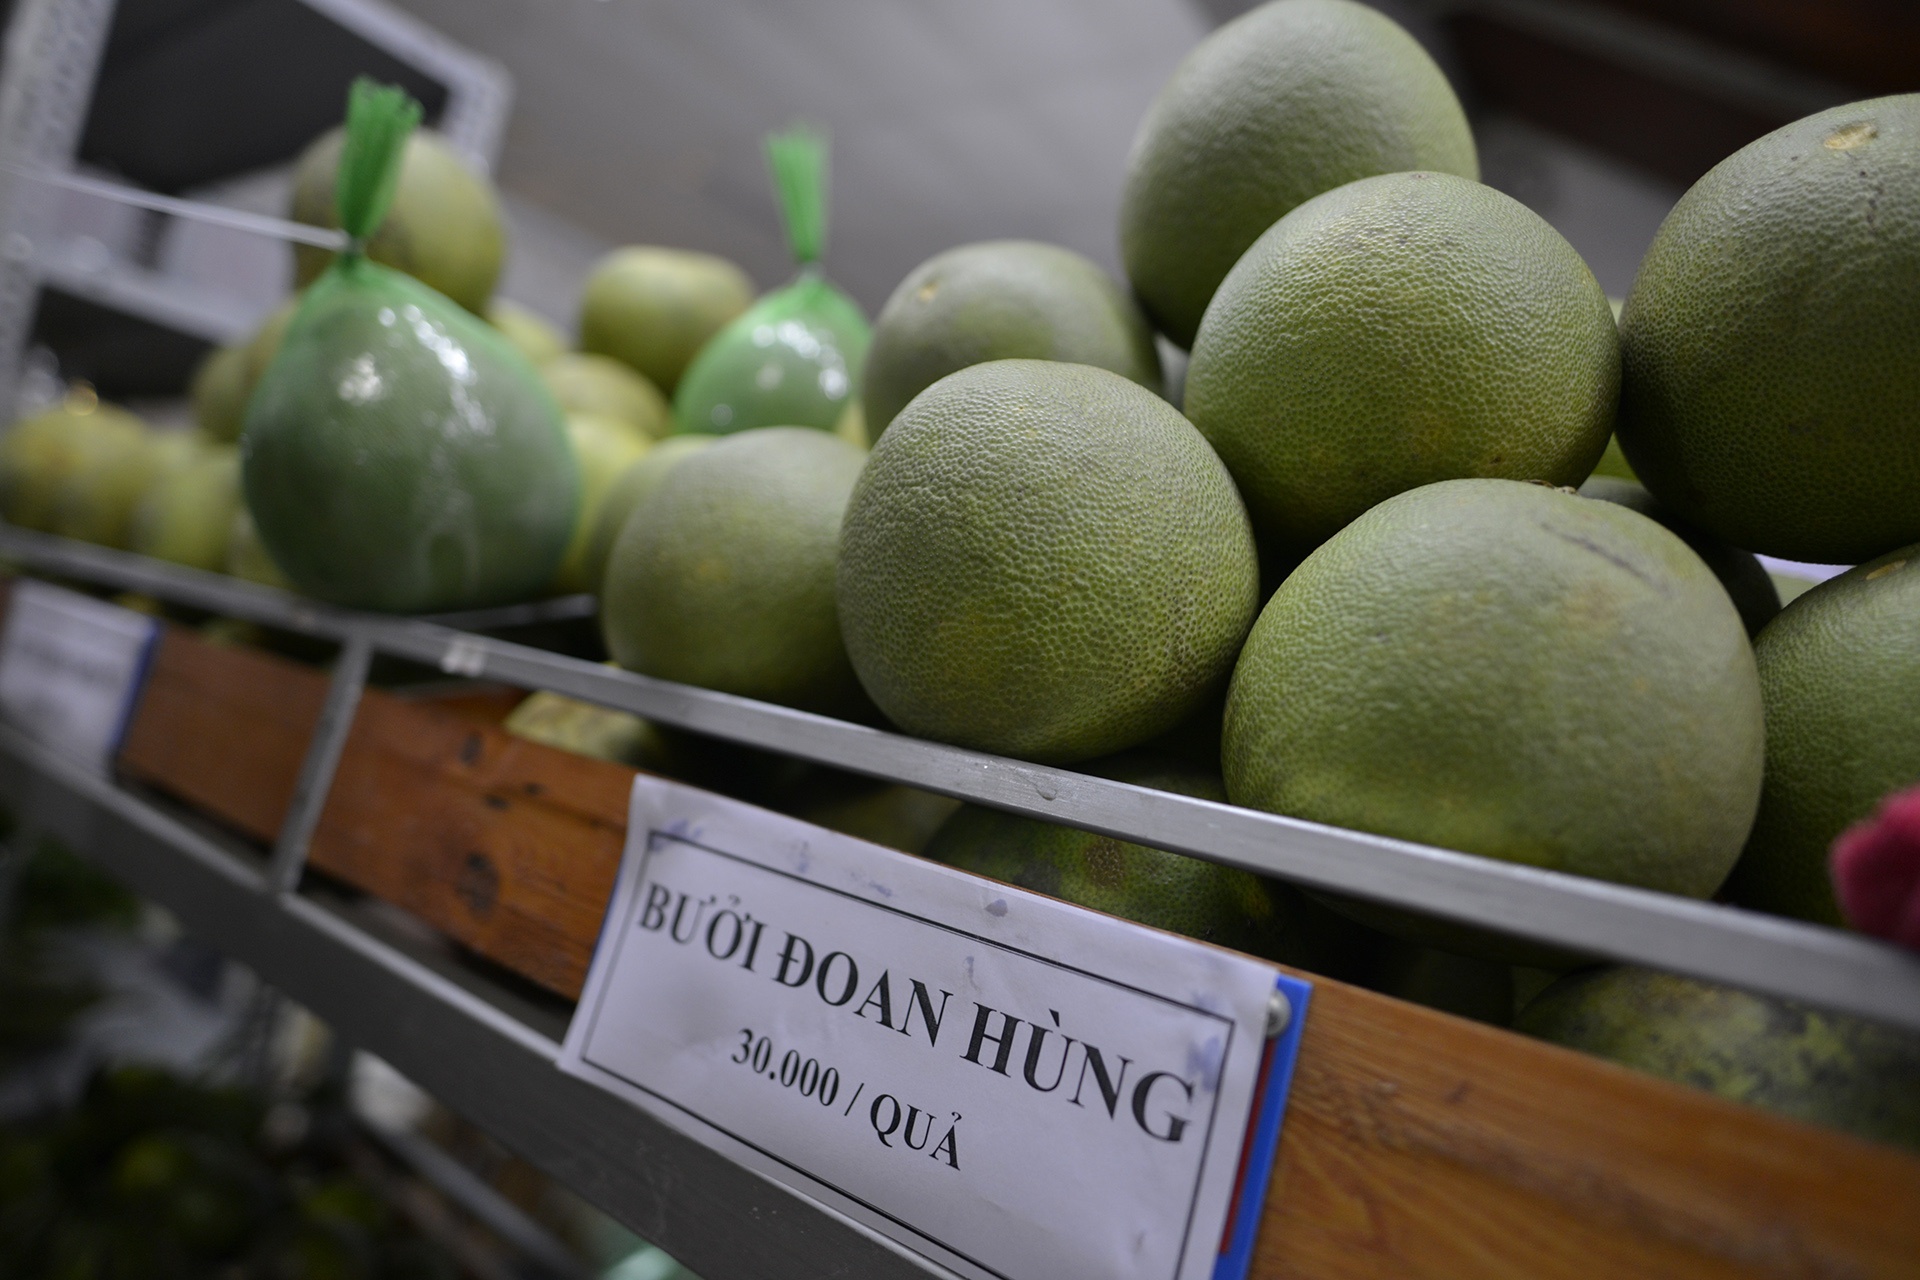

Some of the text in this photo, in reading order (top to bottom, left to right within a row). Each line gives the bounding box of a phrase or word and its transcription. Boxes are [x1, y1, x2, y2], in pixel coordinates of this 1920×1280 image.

[638, 882, 1196, 1144] BƯỞI ĐOAN HÙNG
[731, 1028, 962, 1171] 30.000 / QUẢ
